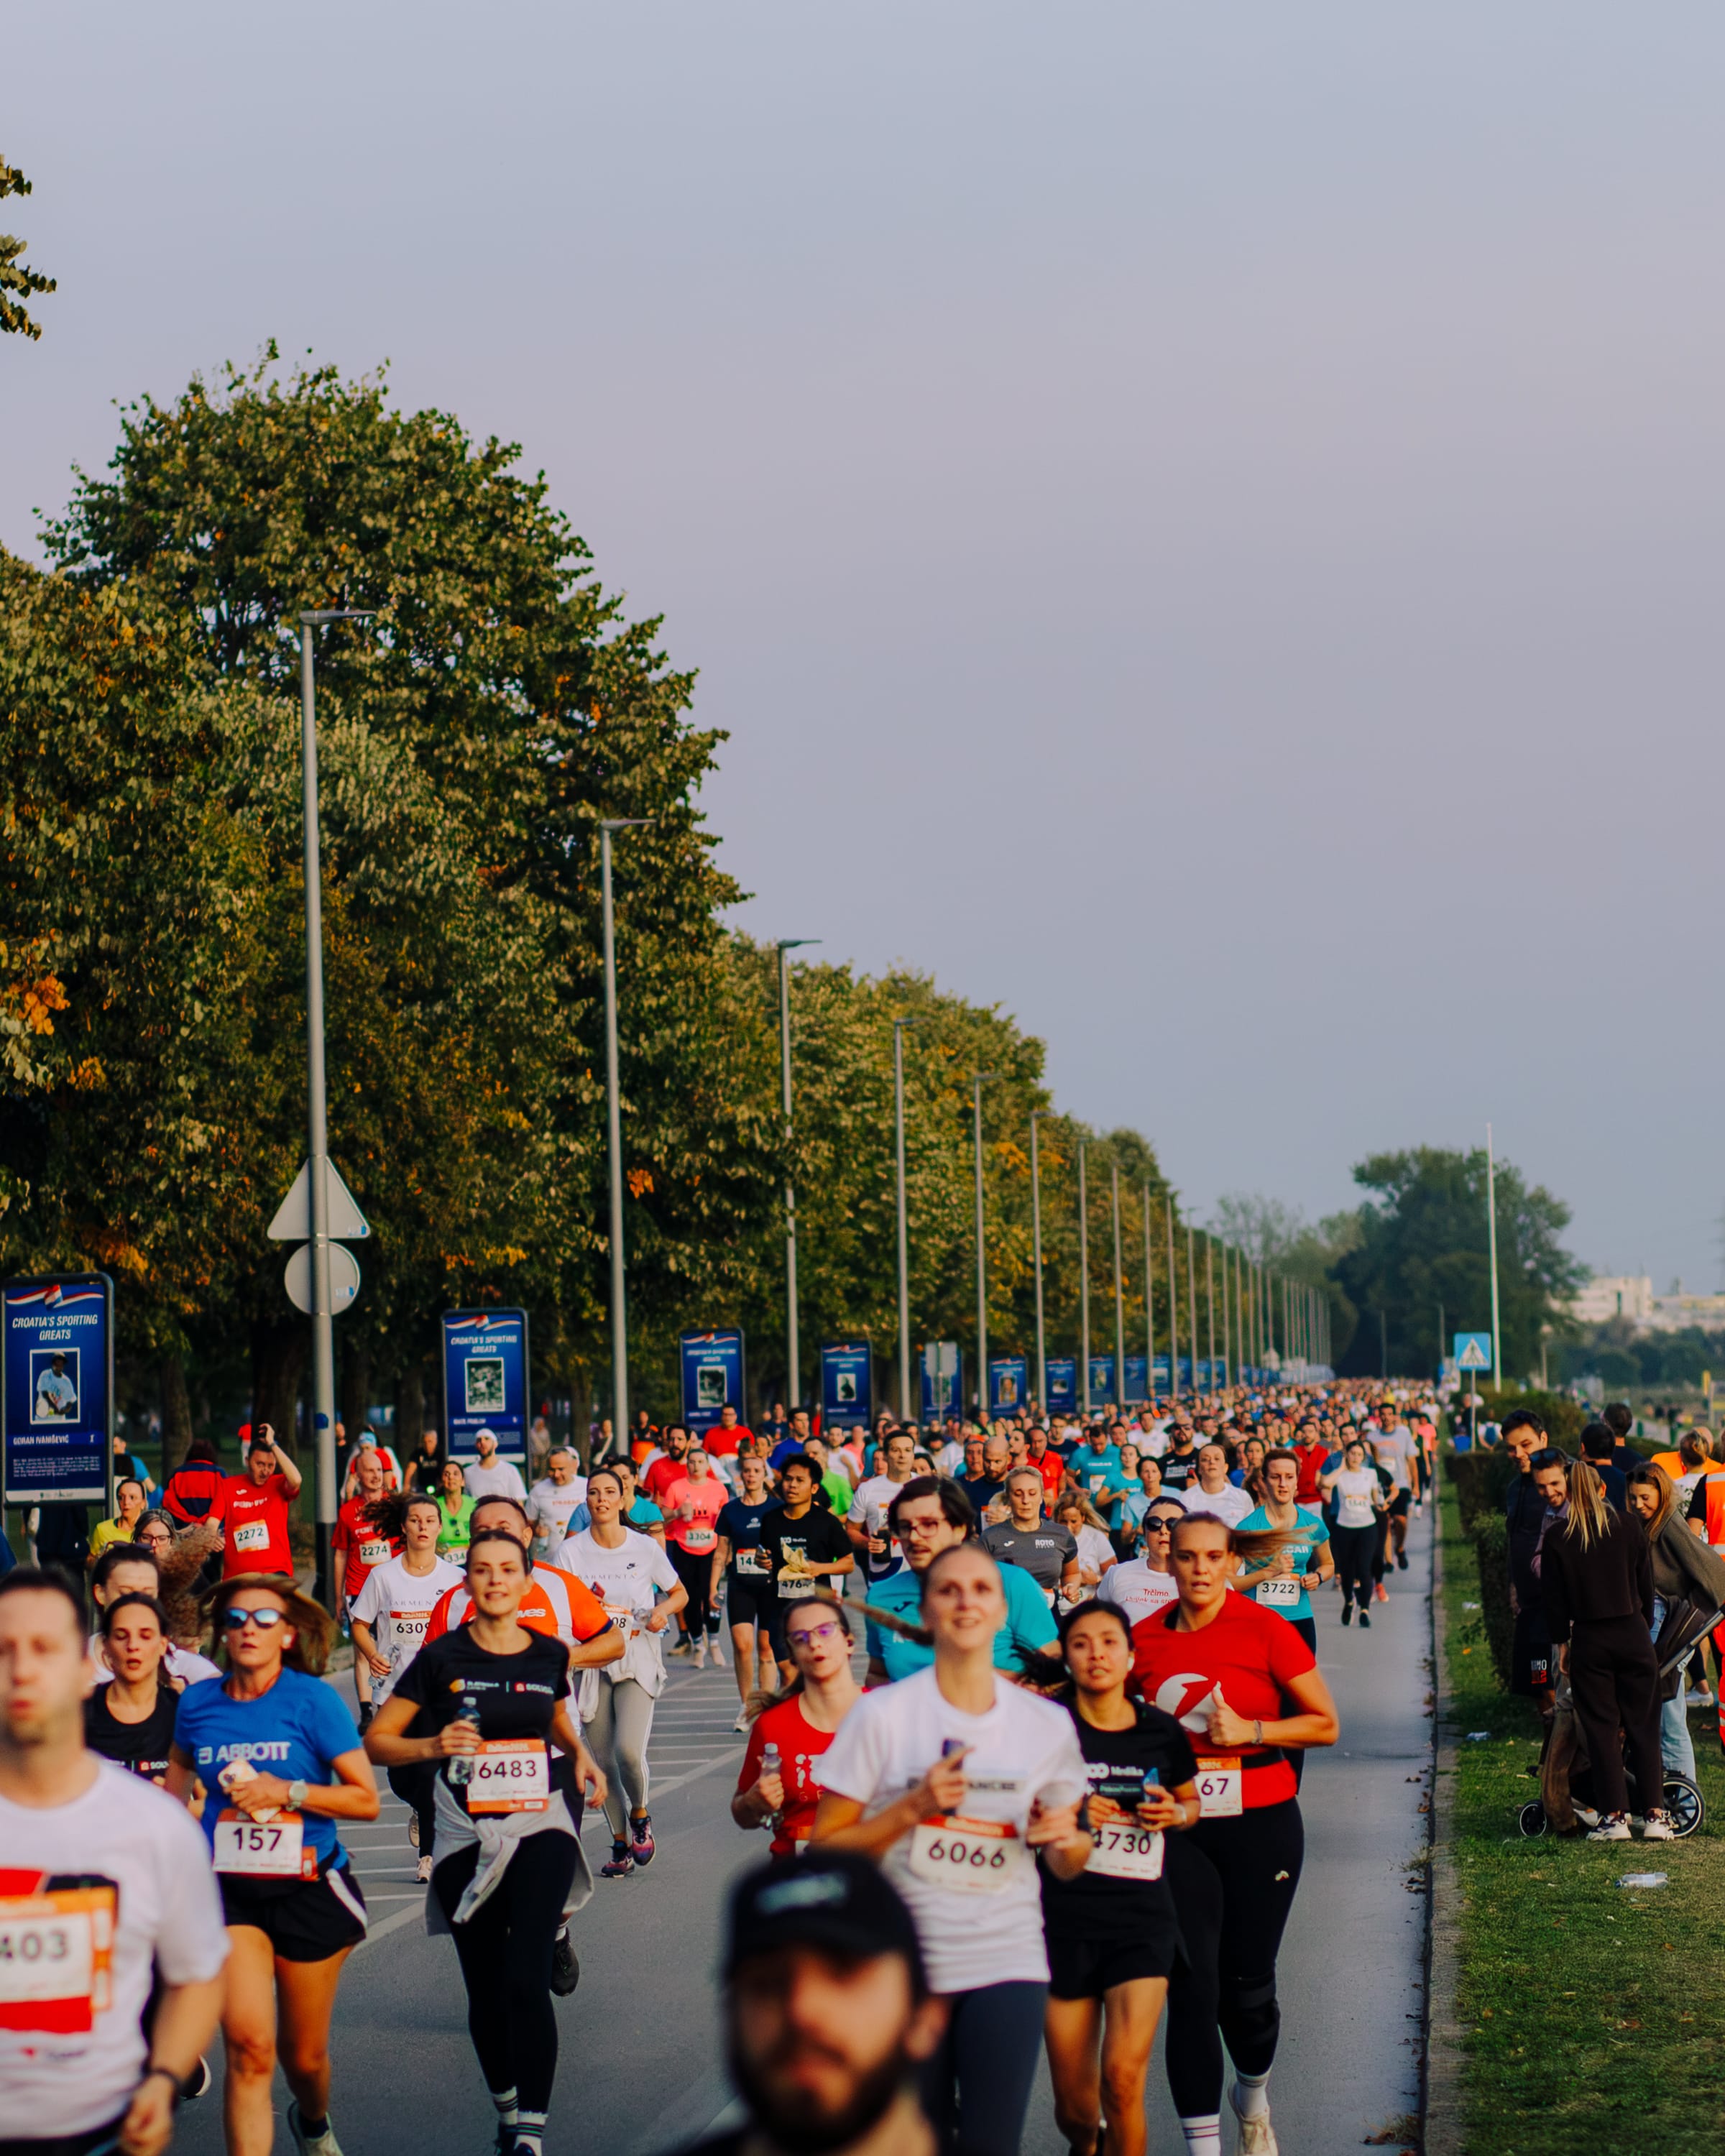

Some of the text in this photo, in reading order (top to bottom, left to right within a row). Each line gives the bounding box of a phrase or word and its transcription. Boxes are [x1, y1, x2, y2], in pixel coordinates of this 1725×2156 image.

[12, 1314, 98, 1328] CROATIA'S SPORTING
[39, 1330, 71, 1340] GREATS
[238, 1528, 263, 1542] 2272
[362, 1545, 387, 1556] 2274
[1262, 1583, 1294, 1593] 3722
[216, 1741, 291, 1762] ABBOTT
[479, 1760, 536, 1779] 6483
[1201, 1778, 1229, 1795] 67
[234, 1827, 282, 1851] 157
[1092, 1830, 1151, 1854] 4730
[929, 1840, 1005, 1869] 6066
